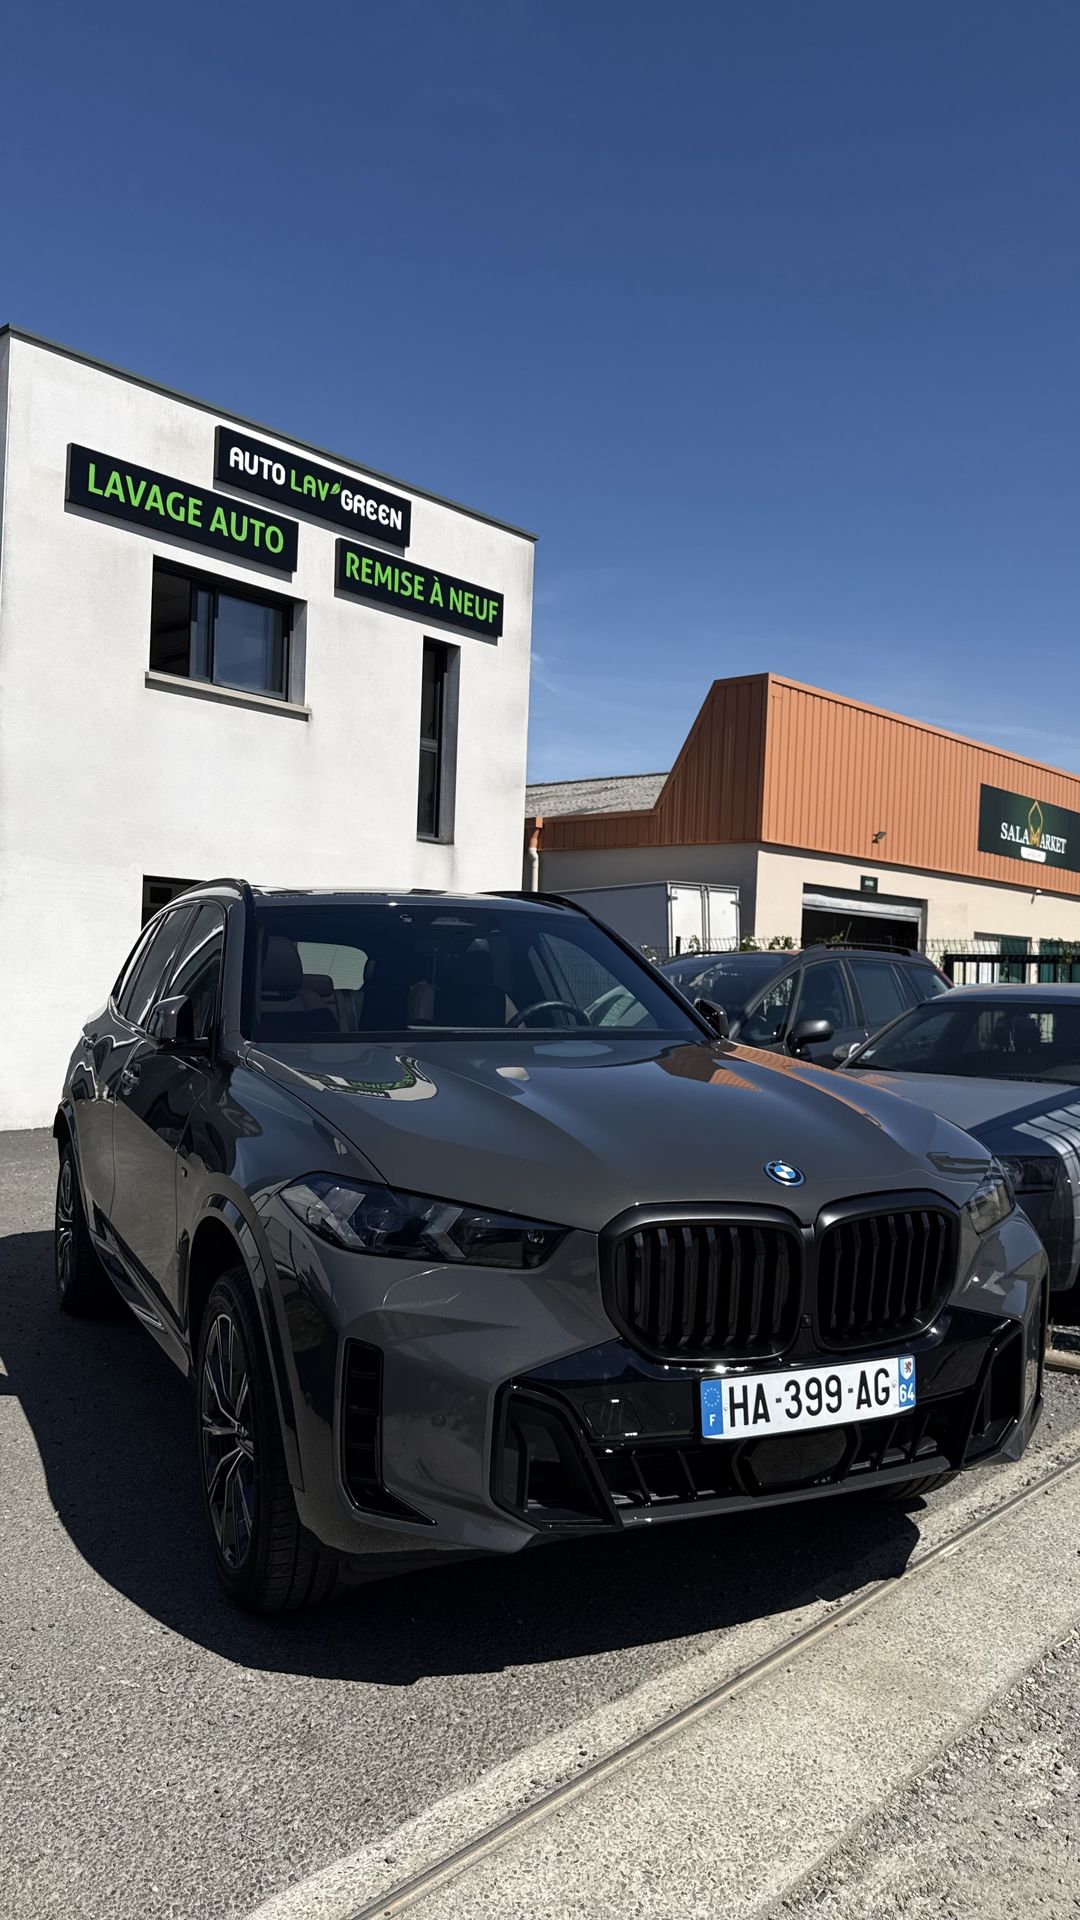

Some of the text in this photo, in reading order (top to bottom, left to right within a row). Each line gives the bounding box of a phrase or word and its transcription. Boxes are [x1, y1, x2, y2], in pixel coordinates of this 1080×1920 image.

[229, 446, 286, 485] AUTO
[88, 463, 284, 553] LAVAGE AUTO
[345, 551, 499, 623] REMISE À NEUF
[709, 1368, 914, 1427] F HA-399-AG 64
